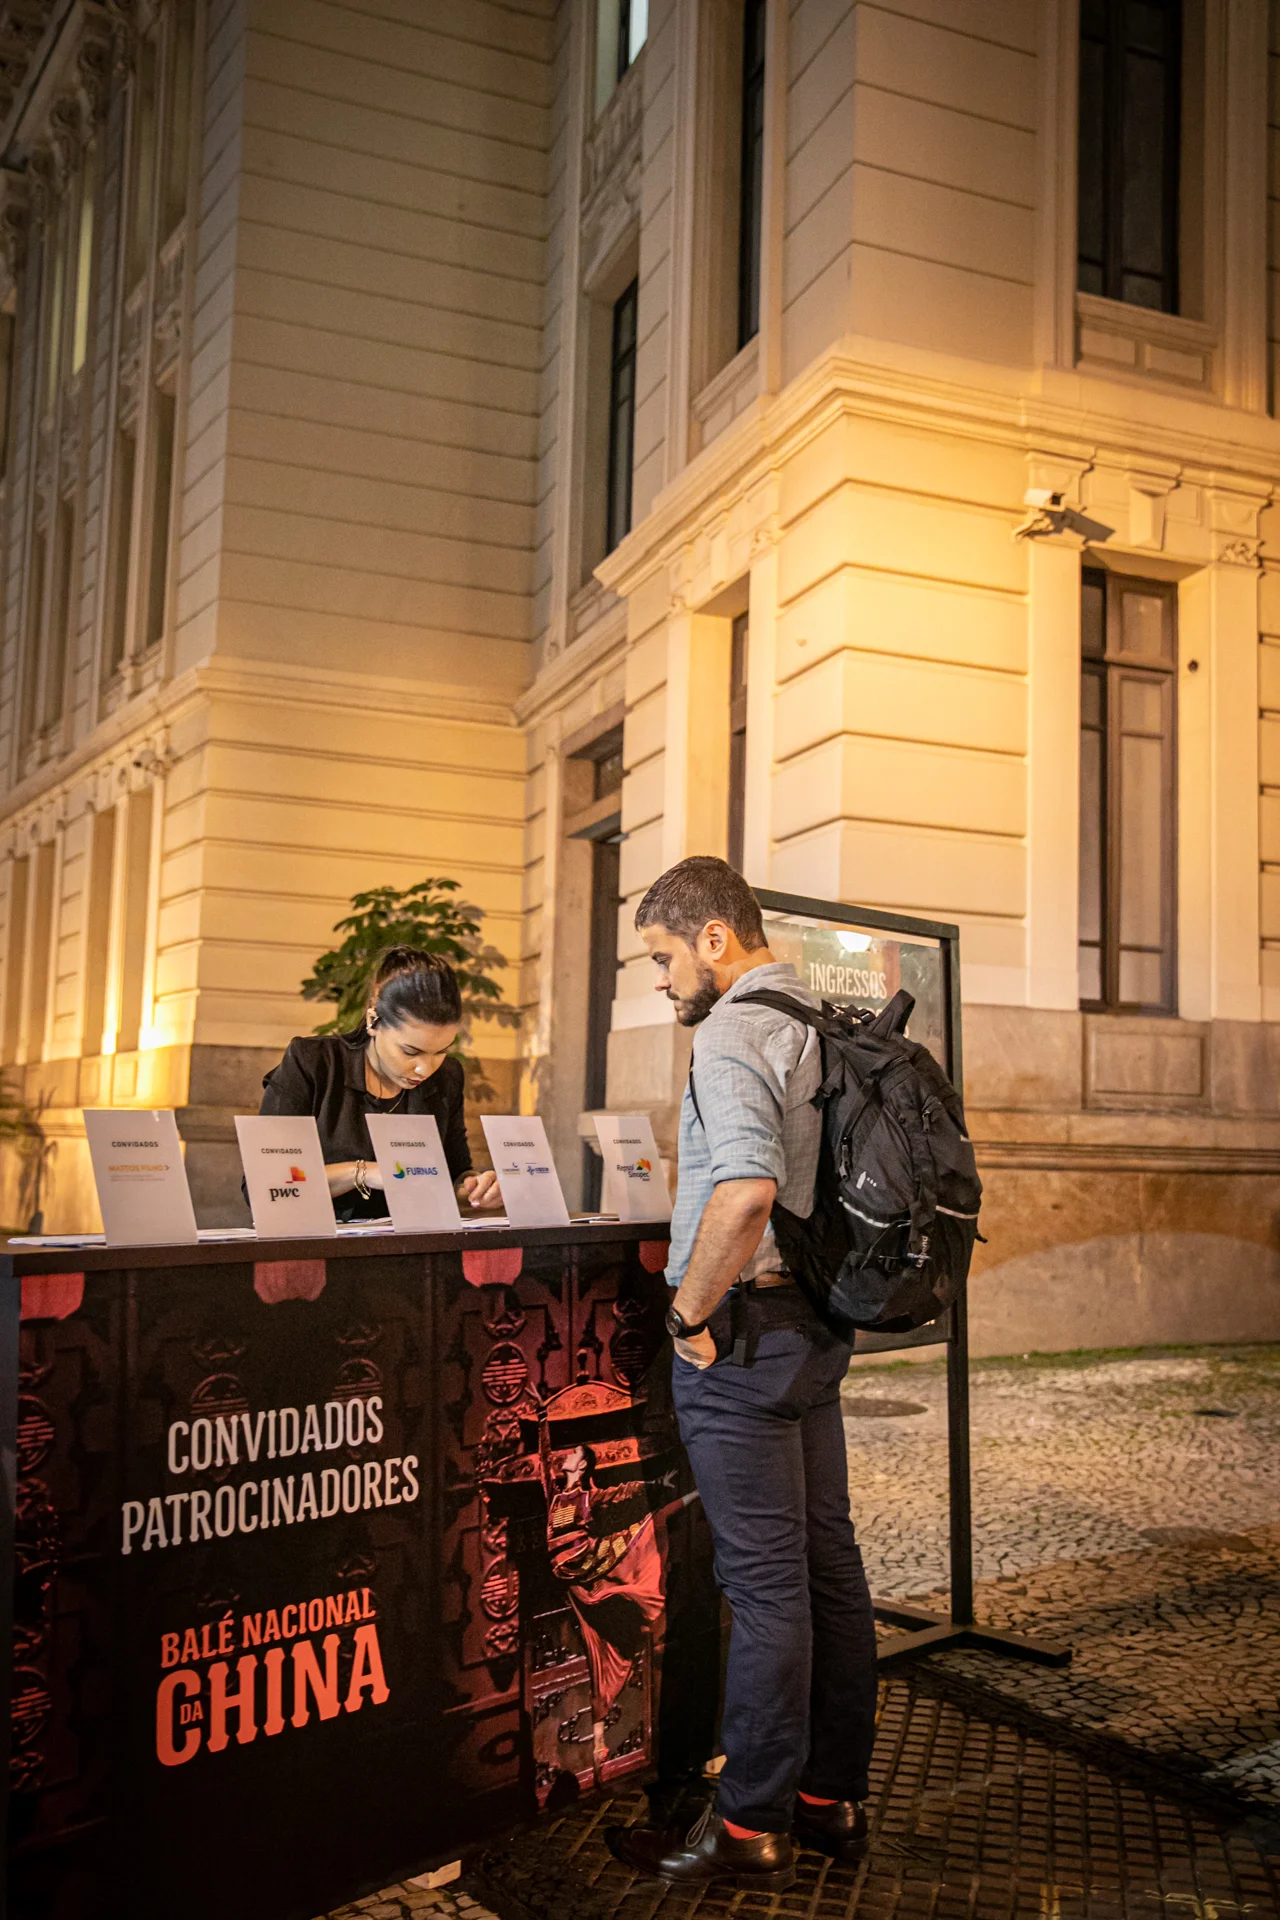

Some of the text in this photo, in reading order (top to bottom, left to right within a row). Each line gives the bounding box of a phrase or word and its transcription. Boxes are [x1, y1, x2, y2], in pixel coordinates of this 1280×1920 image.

[809, 962, 887, 1000] INGRESSOS
[269, 1187, 300, 1201] pwc
[405, 1166, 438, 1176] FURNAS
[167, 1395, 384, 1475] CONVIDADOS
[120, 1454, 420, 1556] PATROCINADORES
[160, 1587, 377, 1669] BALÉ NACIONAL
[155, 1623, 391, 1767] CHINA
[179, 1700, 204, 1725] DA
